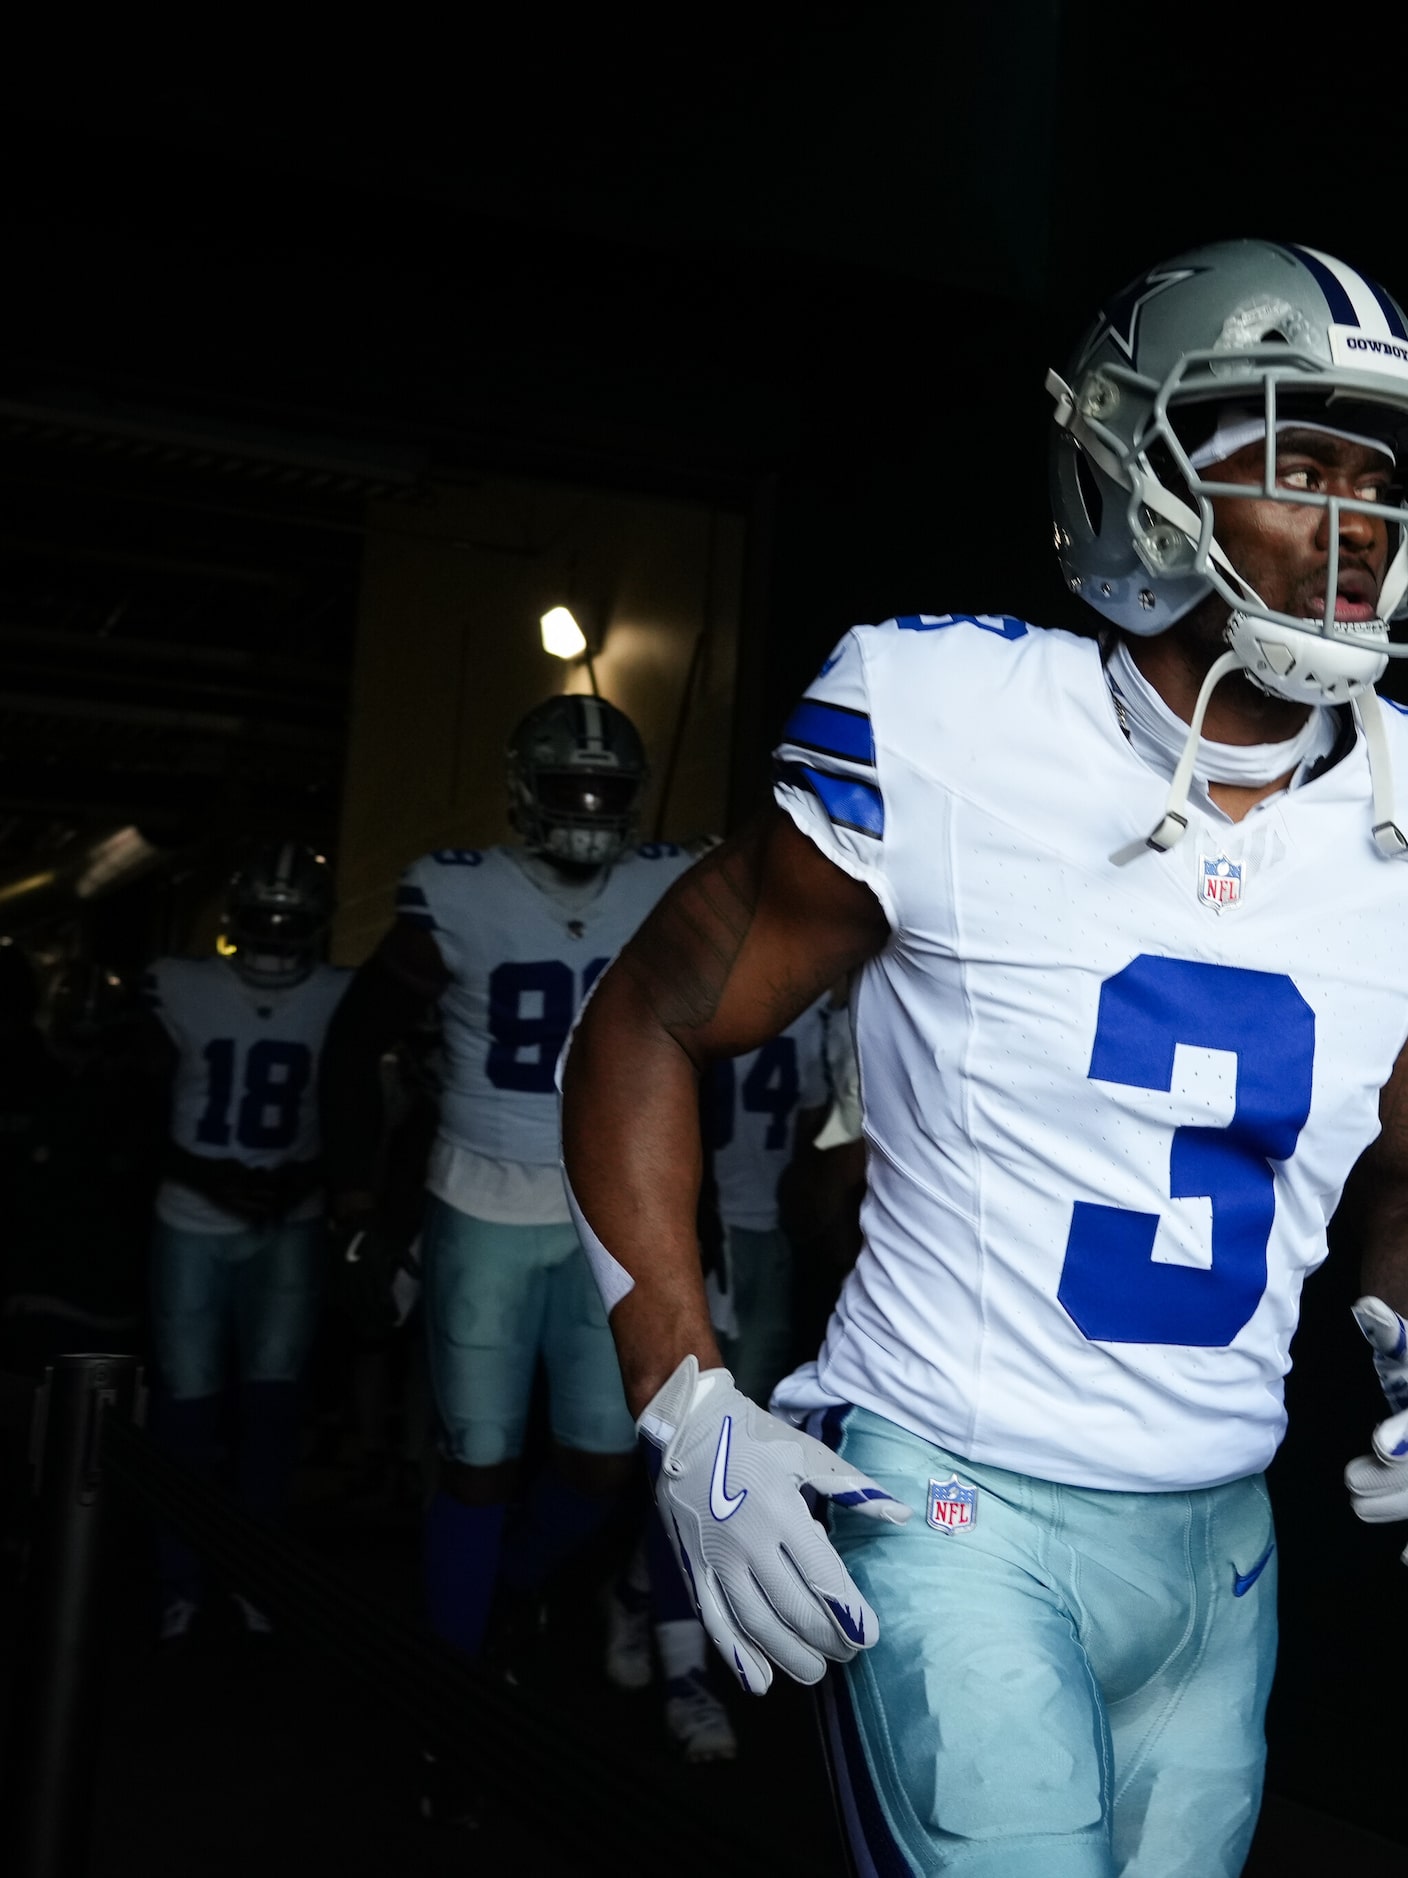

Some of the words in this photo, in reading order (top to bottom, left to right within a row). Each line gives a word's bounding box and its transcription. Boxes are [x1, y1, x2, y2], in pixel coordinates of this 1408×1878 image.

[1207, 878, 1237, 902] NFL
[488, 958, 612, 1093] 8
[197, 1039, 310, 1148] 18
[1057, 953, 1316, 1347] 3
[935, 1501, 969, 1525] NFL
